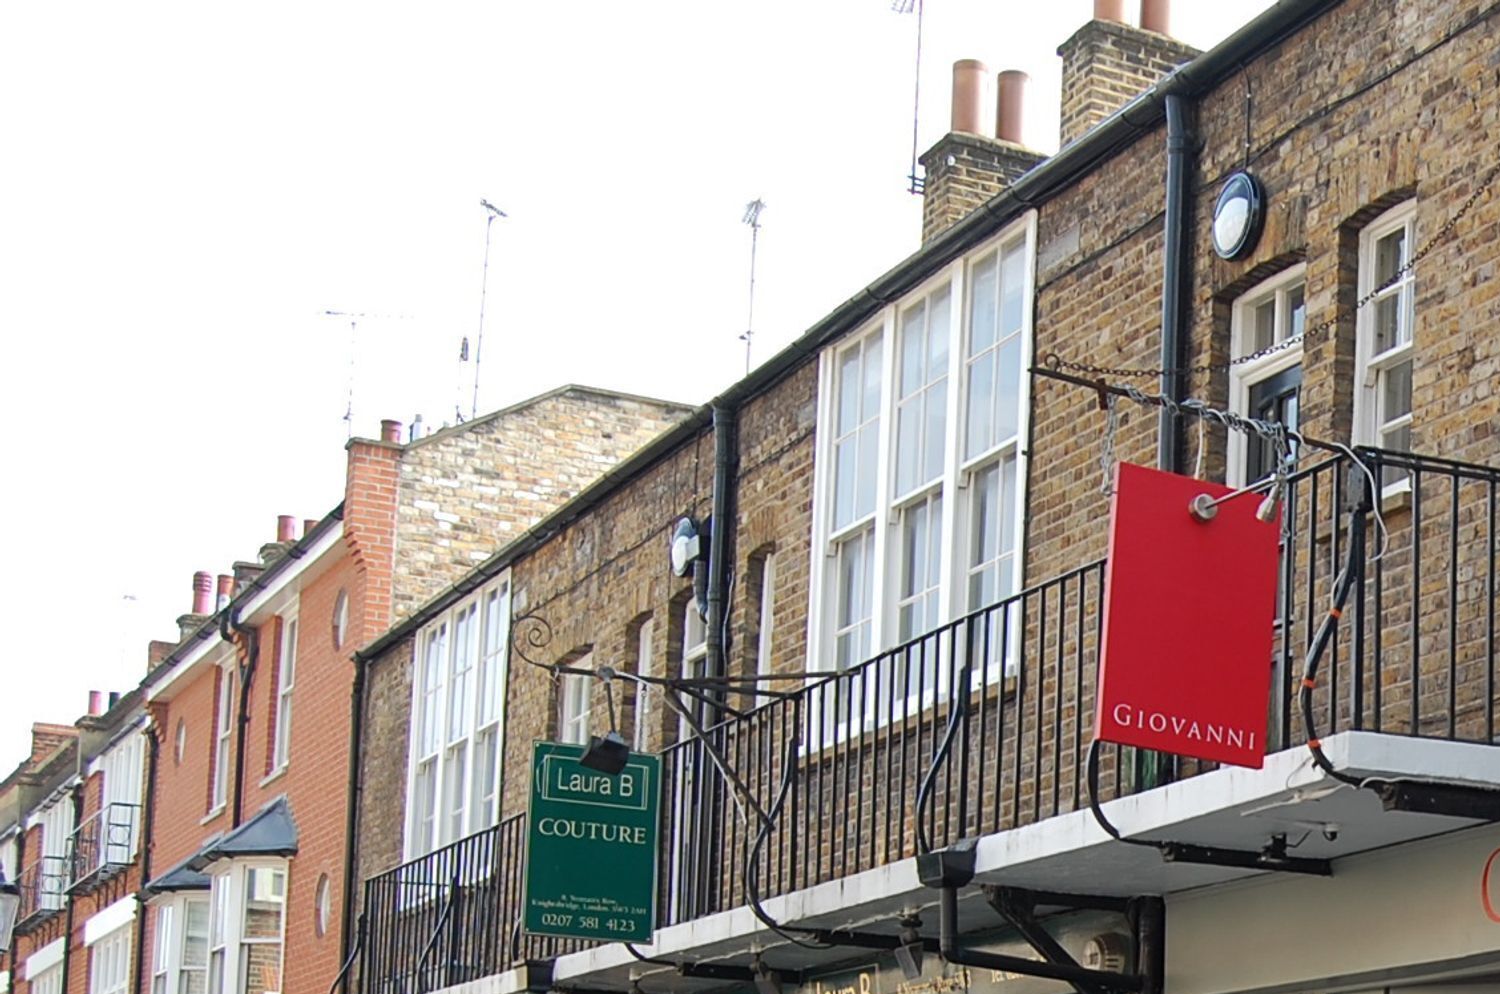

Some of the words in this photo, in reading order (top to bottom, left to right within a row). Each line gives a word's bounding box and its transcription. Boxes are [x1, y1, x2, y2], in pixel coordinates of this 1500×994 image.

[1113, 703, 1255, 750] GIOVANNI
[558, 767, 612, 795] Laura
[619, 774, 633, 797] B
[538, 818, 647, 844] COUTURE
[541, 913, 573, 928] 0207
[578, 916, 599, 930] 581
[605, 918, 636, 932] 4123
